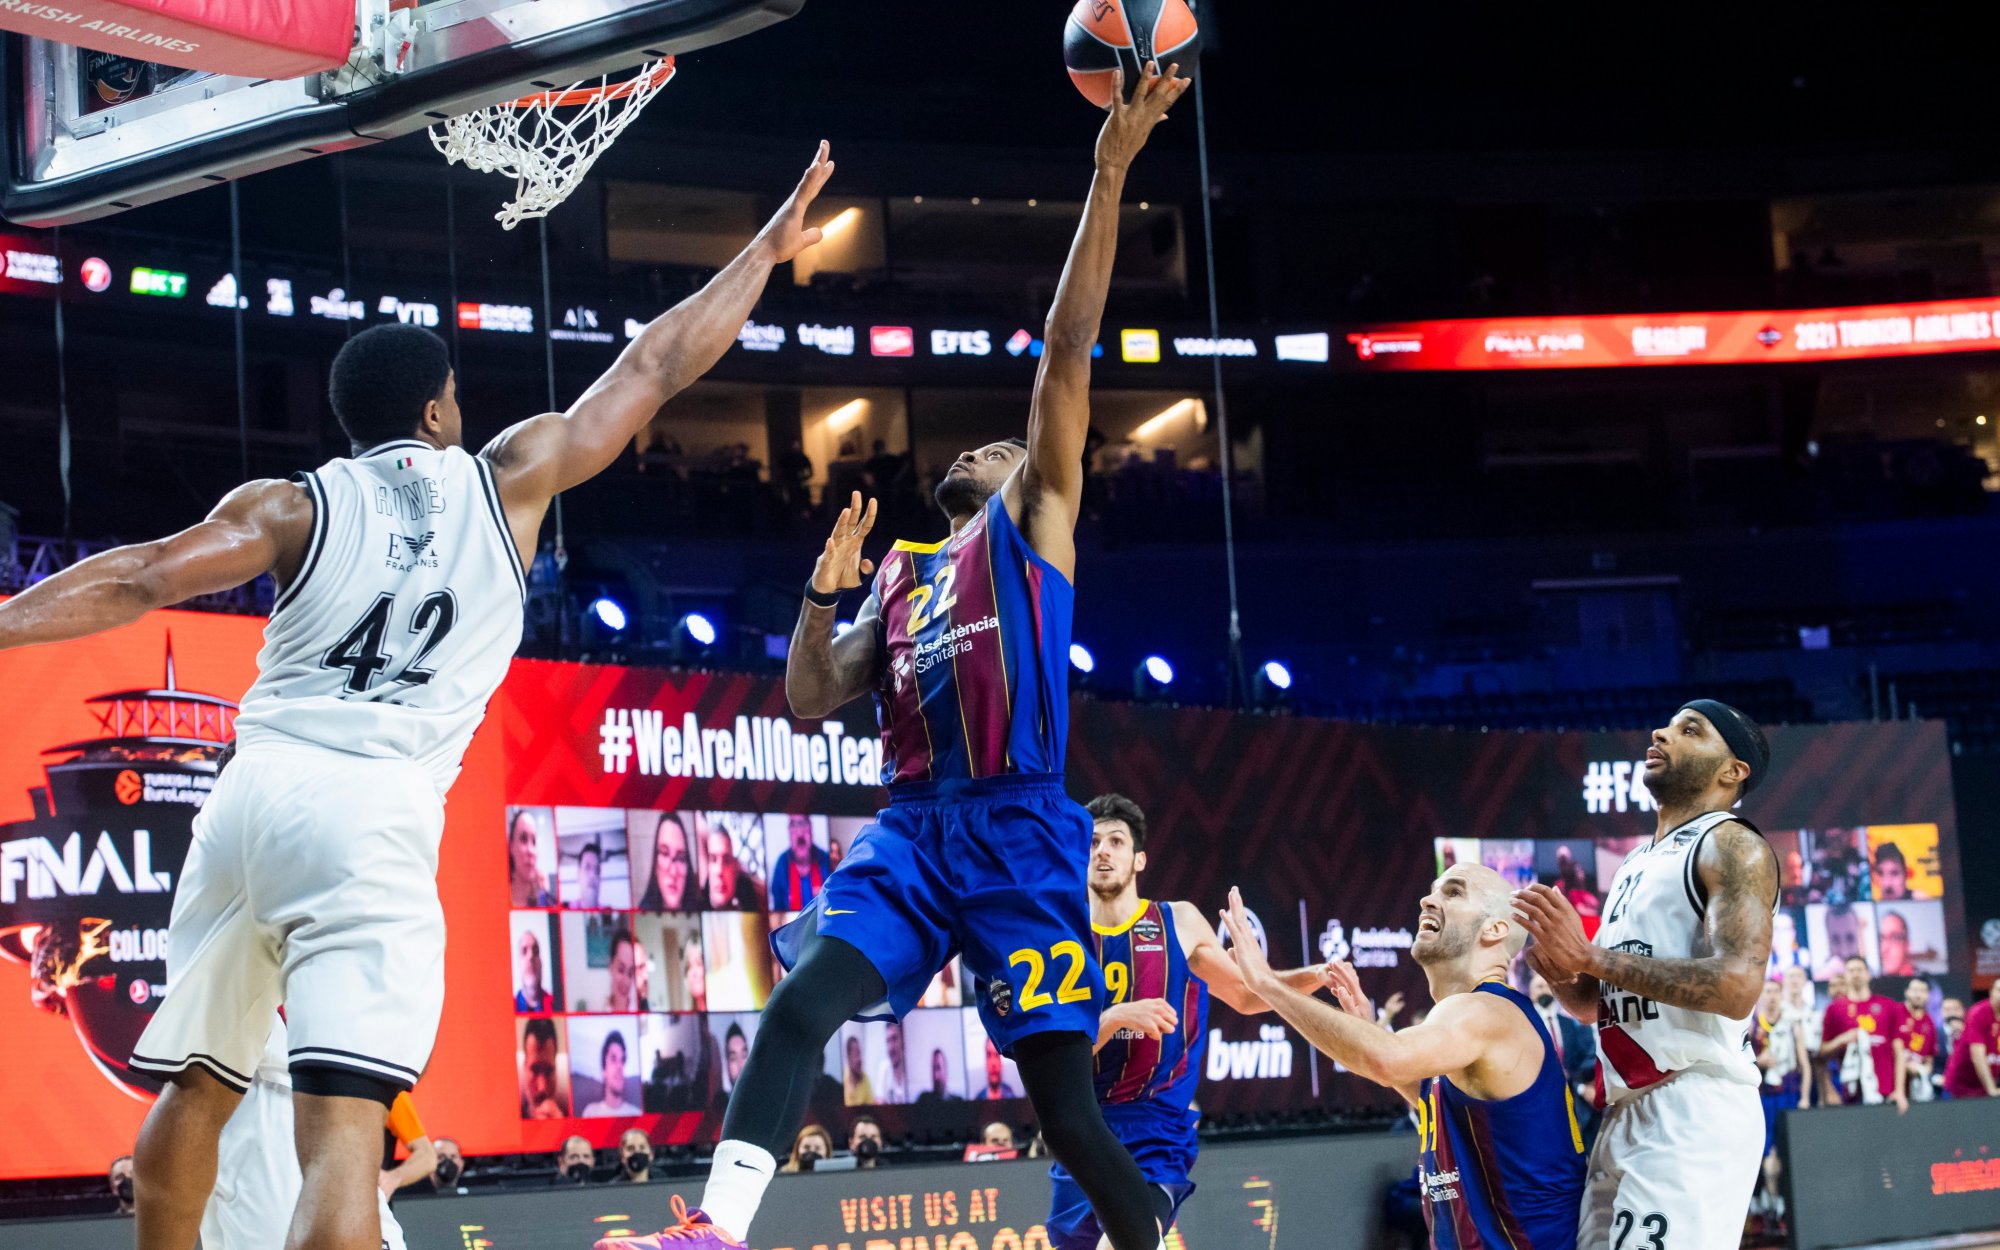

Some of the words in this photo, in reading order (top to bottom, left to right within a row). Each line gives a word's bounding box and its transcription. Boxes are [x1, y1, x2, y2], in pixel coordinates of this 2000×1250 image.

[80, 19, 200, 53] AIRLINES
[397, 302, 440, 328] VTB
[930, 329, 992, 356] EFES
[907, 564, 957, 637] 22
[319, 586, 459, 695] 42
[914, 615, 999, 658] Assistència
[916, 640, 973, 674] Sanitària
[0, 829, 171, 903] FINAL
[1008, 940, 1092, 1013] 22
[1104, 961, 1129, 1004] 9
[1206, 1028, 1293, 1081] bwin
[840, 1194, 913, 1233] VISIT
[924, 1191, 959, 1227] US
[969, 1188, 999, 1224] AT
[1614, 1207, 1670, 1250] 23
